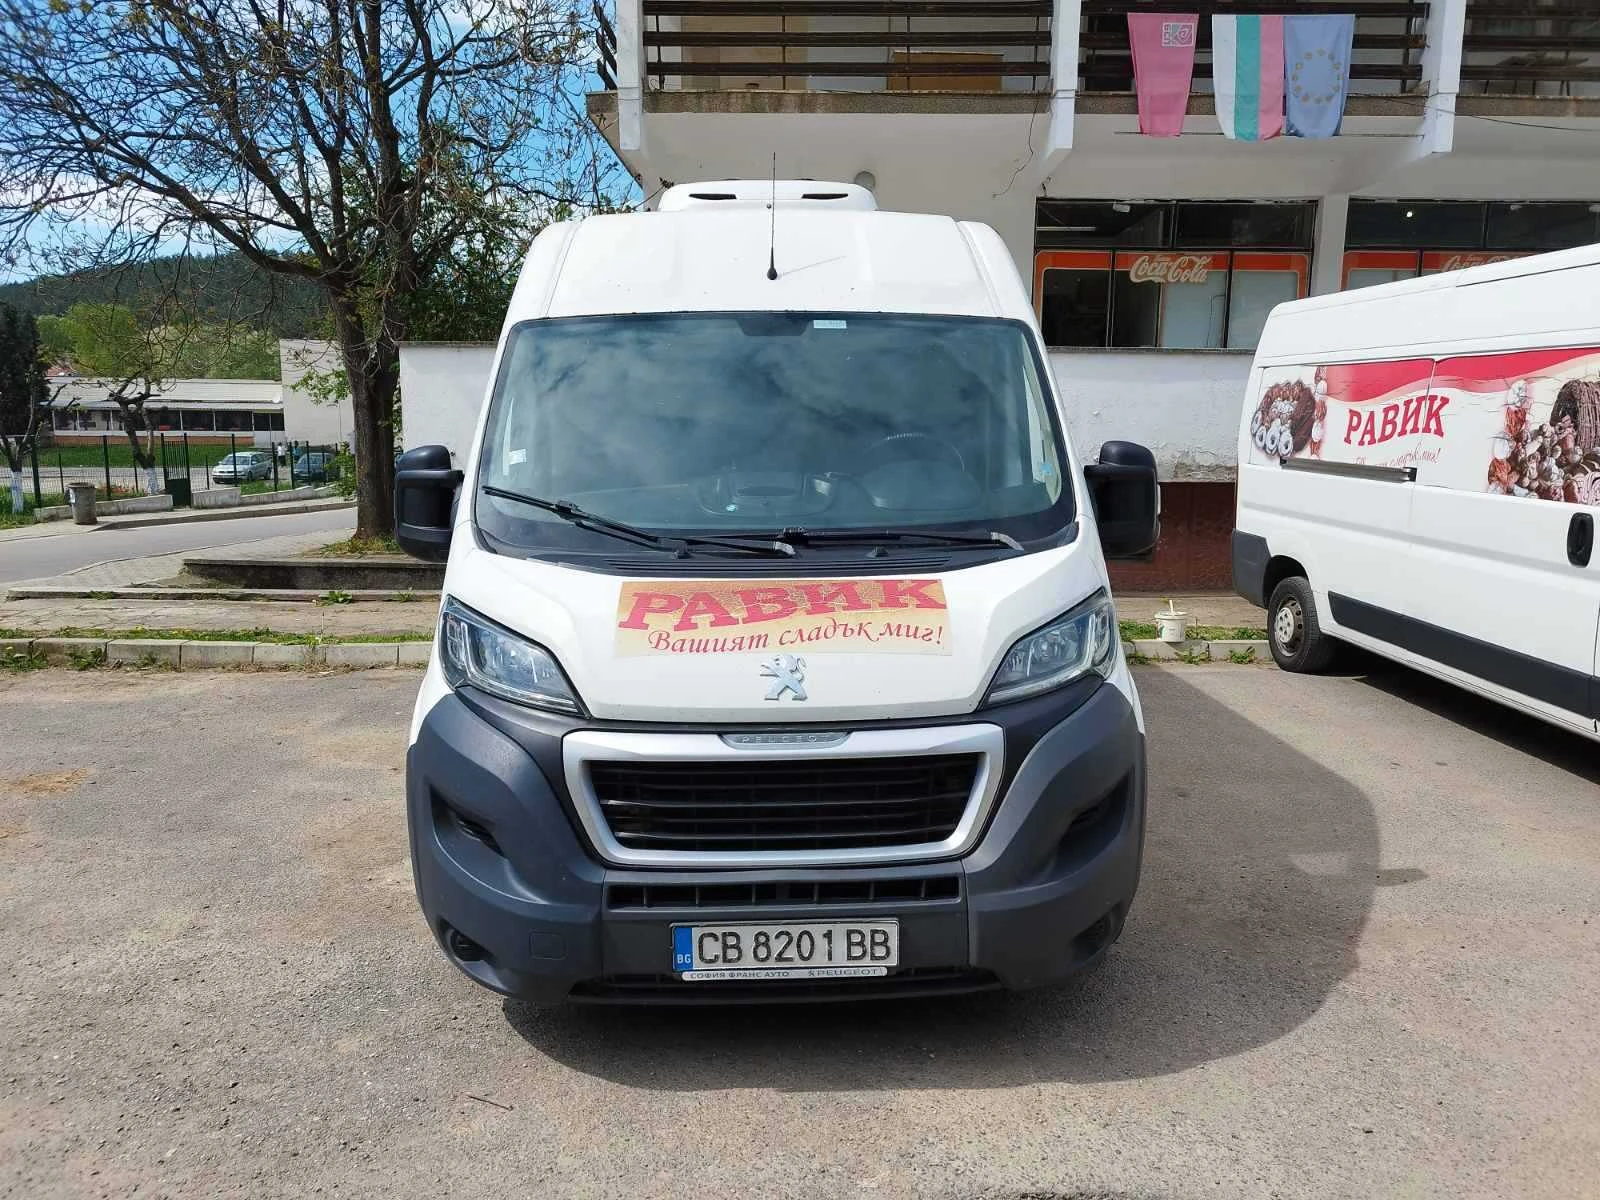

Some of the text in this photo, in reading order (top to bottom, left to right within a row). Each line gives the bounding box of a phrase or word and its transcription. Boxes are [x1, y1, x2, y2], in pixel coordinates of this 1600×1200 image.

[1344, 394, 1450, 446] РАВИК
[618, 579, 947, 632] РАВИК
[648, 617, 943, 653] Вашият сладък миг!
[677, 954, 691, 964] BG
[698, 929, 891, 964] CB 8201 BB
